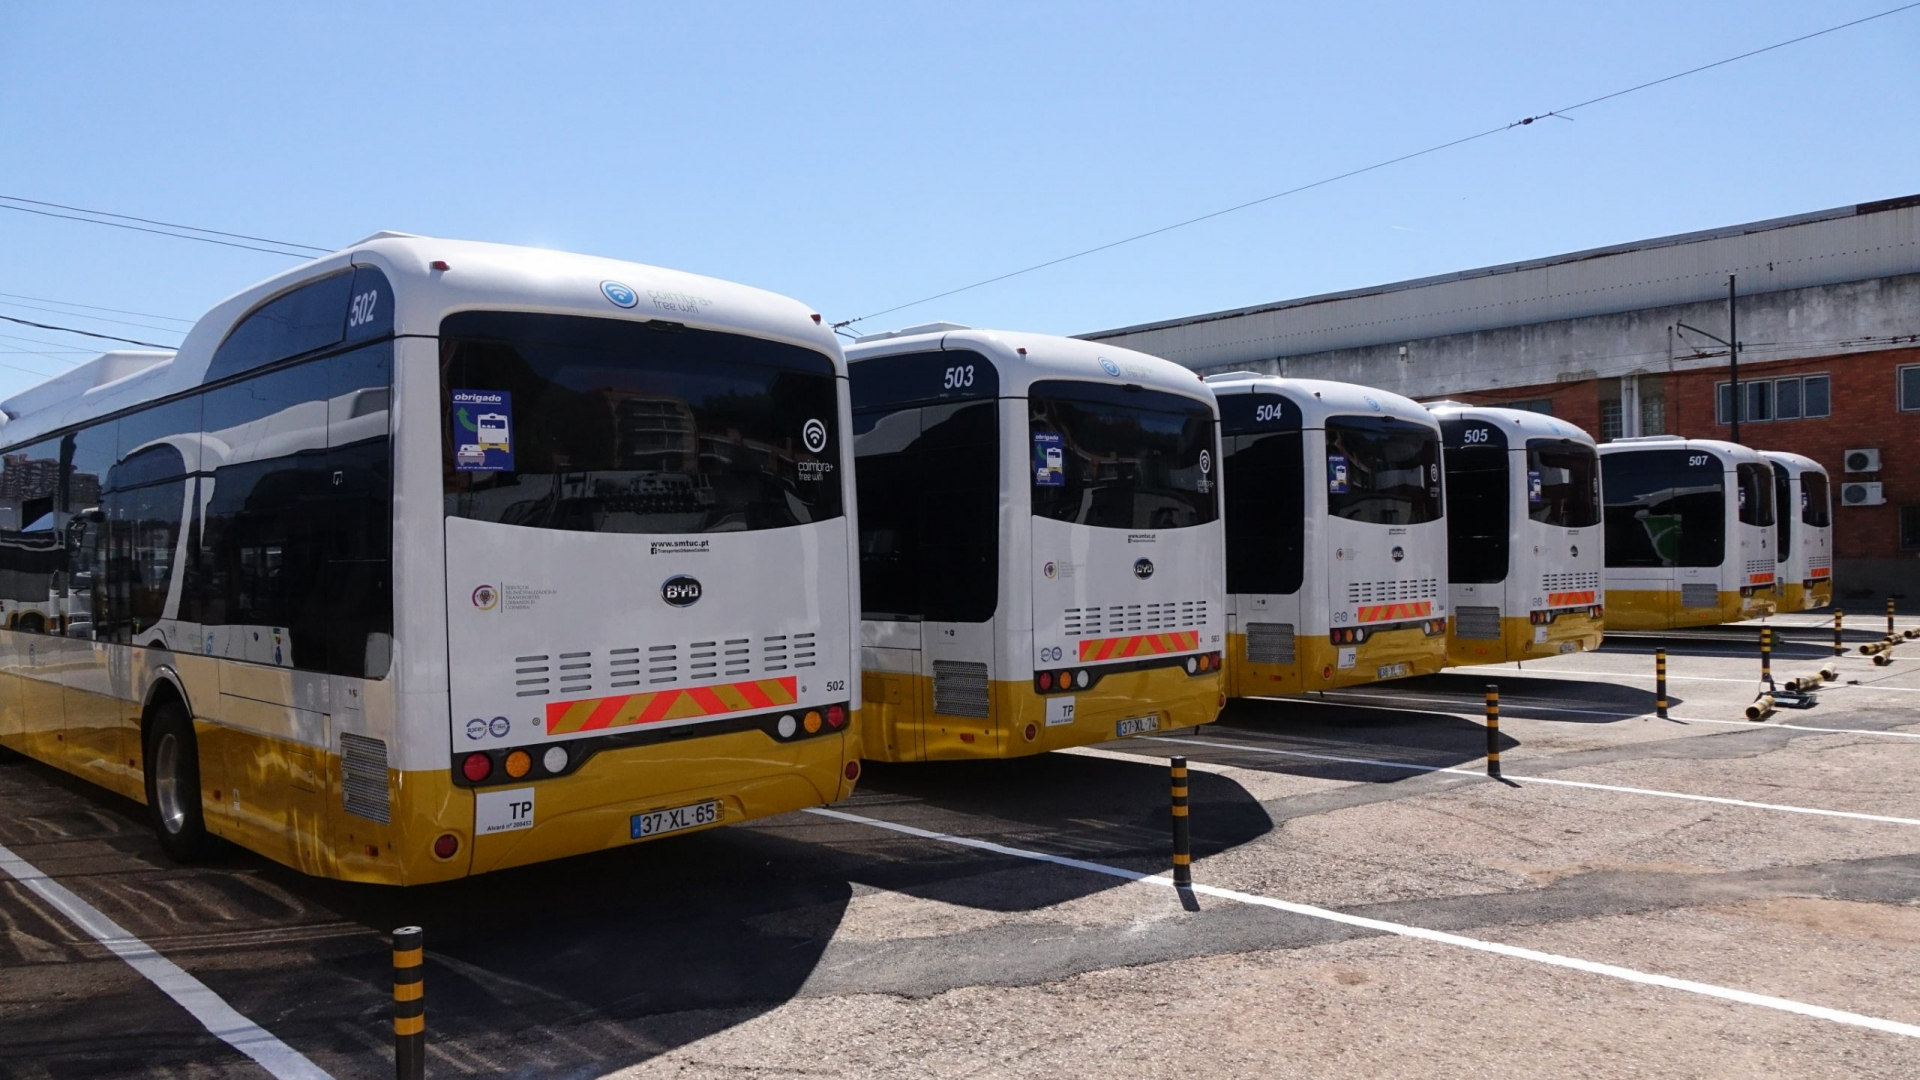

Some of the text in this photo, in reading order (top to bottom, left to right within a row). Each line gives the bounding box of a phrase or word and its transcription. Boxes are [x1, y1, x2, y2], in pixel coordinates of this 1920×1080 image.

[350, 290, 377, 327] 502
[653, 298, 700, 314] free wifi
[944, 365, 974, 389] 503
[454, 393, 502, 403] obrigado
[1256, 403, 1282, 421] 504
[1464, 429, 1488, 443] 505
[1689, 455, 1708, 466] 507
[650, 540, 709, 548] www.smtuc.pt
[667, 585, 699, 598] BYD
[826, 680, 845, 692] 502
[1062, 705, 1074, 717] TP
[509, 801, 532, 820] TP
